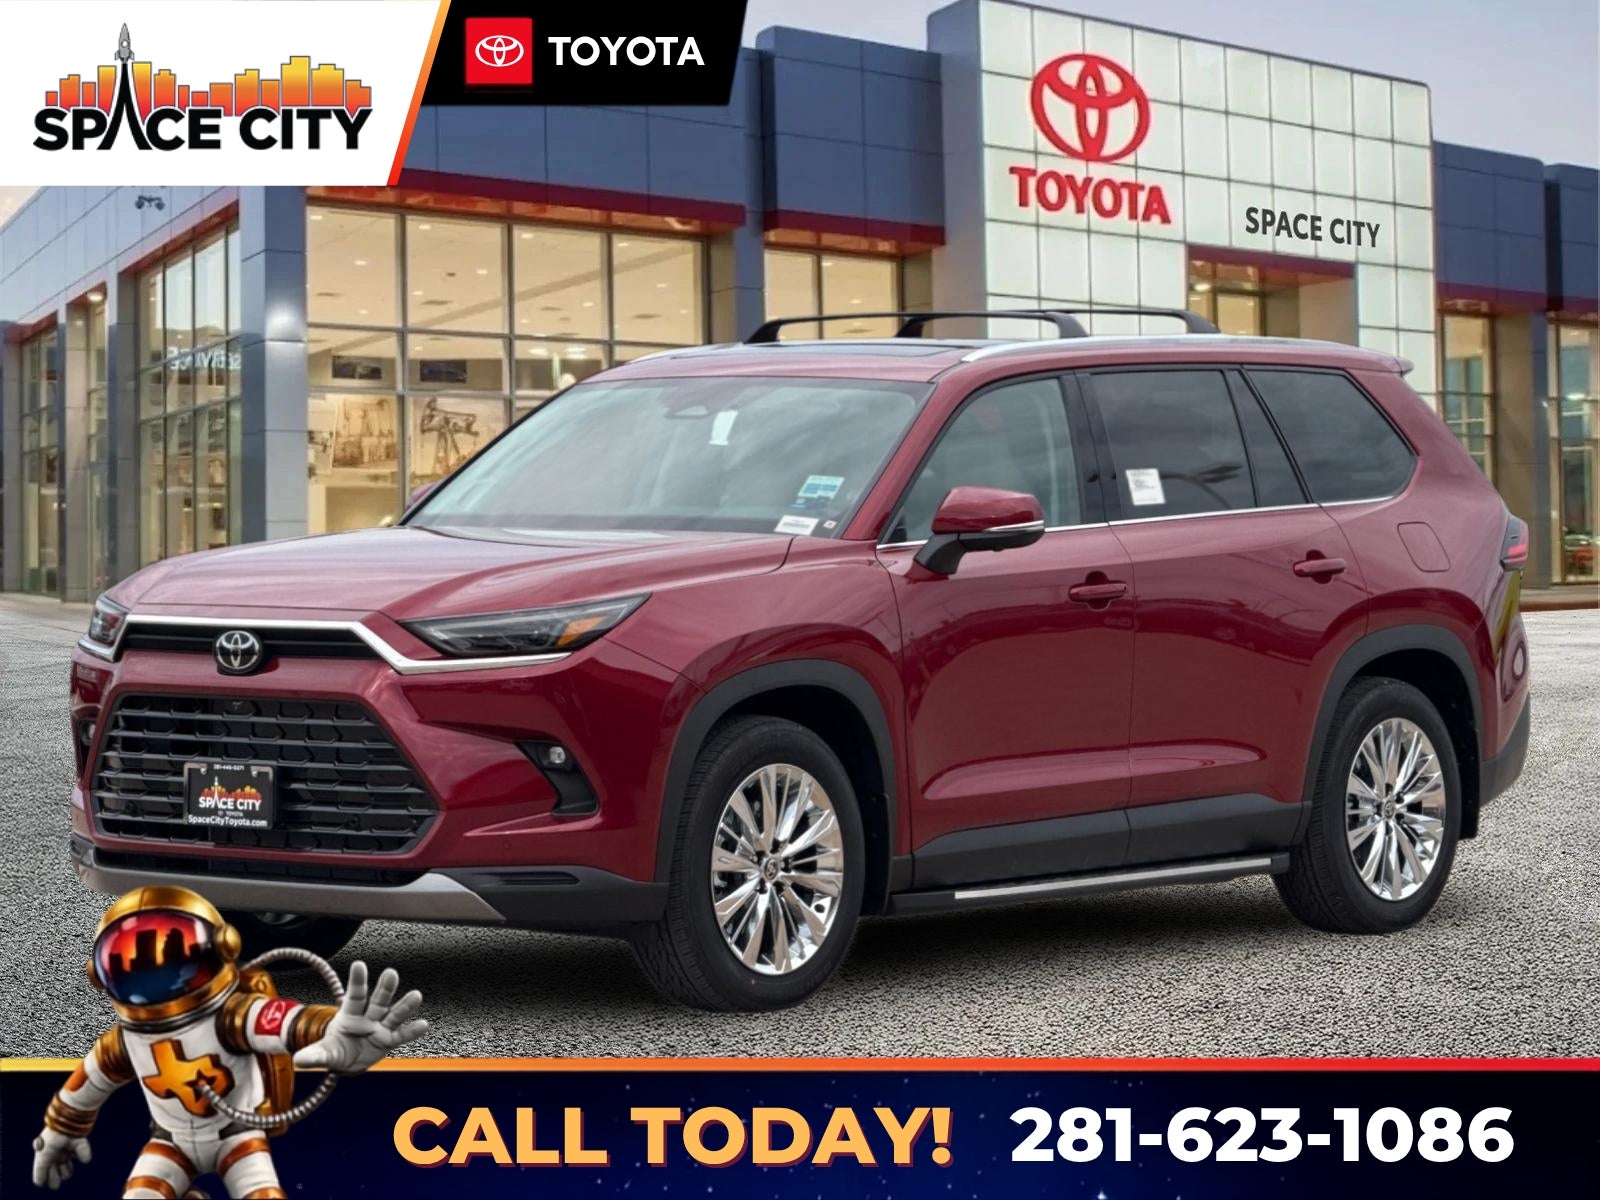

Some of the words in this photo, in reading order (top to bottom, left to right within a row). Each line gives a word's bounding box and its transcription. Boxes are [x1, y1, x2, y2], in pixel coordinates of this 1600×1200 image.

[1009, 166, 1172, 225] TOYOTA
[1245, 206, 1323, 242] SPACE
[1329, 218, 1381, 248] CITY
[198, 796, 235, 810] SPACE
[236, 799, 262, 811] CITY
[188, 814, 268, 827] SpaceCityToyota.com
